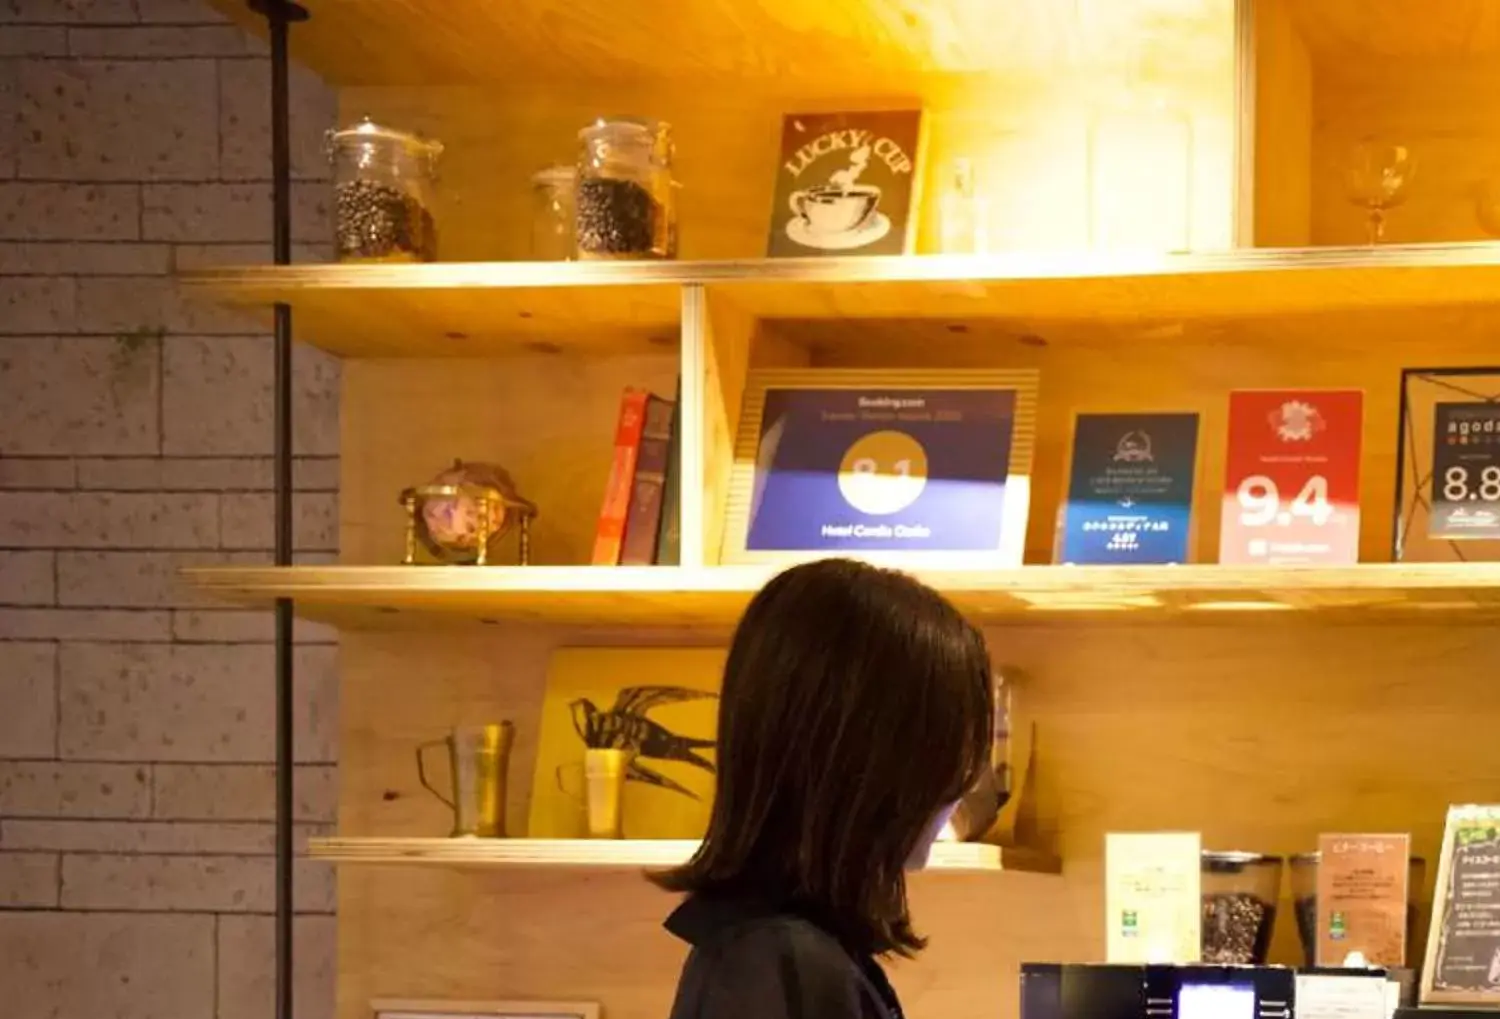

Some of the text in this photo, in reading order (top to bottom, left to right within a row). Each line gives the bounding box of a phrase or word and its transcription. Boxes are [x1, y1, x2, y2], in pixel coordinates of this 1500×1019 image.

[784, 128, 912, 177] LUCKY CUP
[1236, 474, 1335, 527] 9.4
